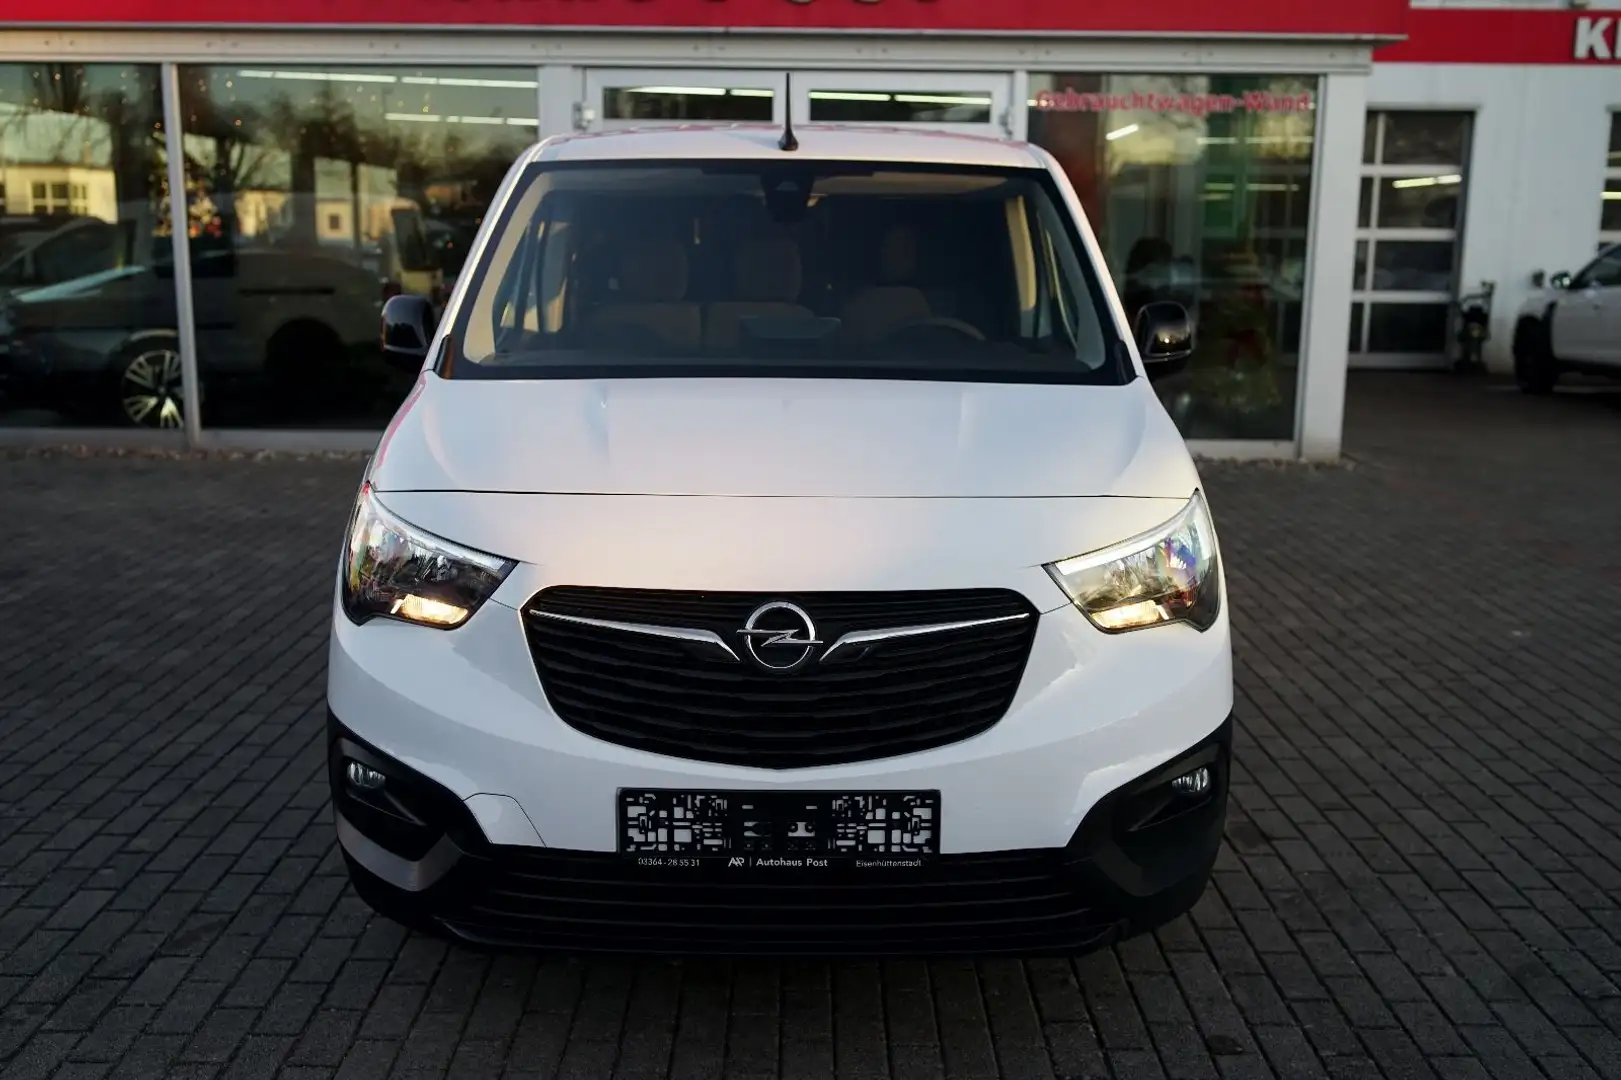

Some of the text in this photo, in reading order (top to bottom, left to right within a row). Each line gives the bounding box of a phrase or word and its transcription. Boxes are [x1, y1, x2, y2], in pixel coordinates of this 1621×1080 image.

[1574, 16, 1621, 59] K
[756, 857, 803, 867] Autohaus
[806, 857, 829, 867] Post
[856, 858, 922, 868] Eisenhüttenstadt
